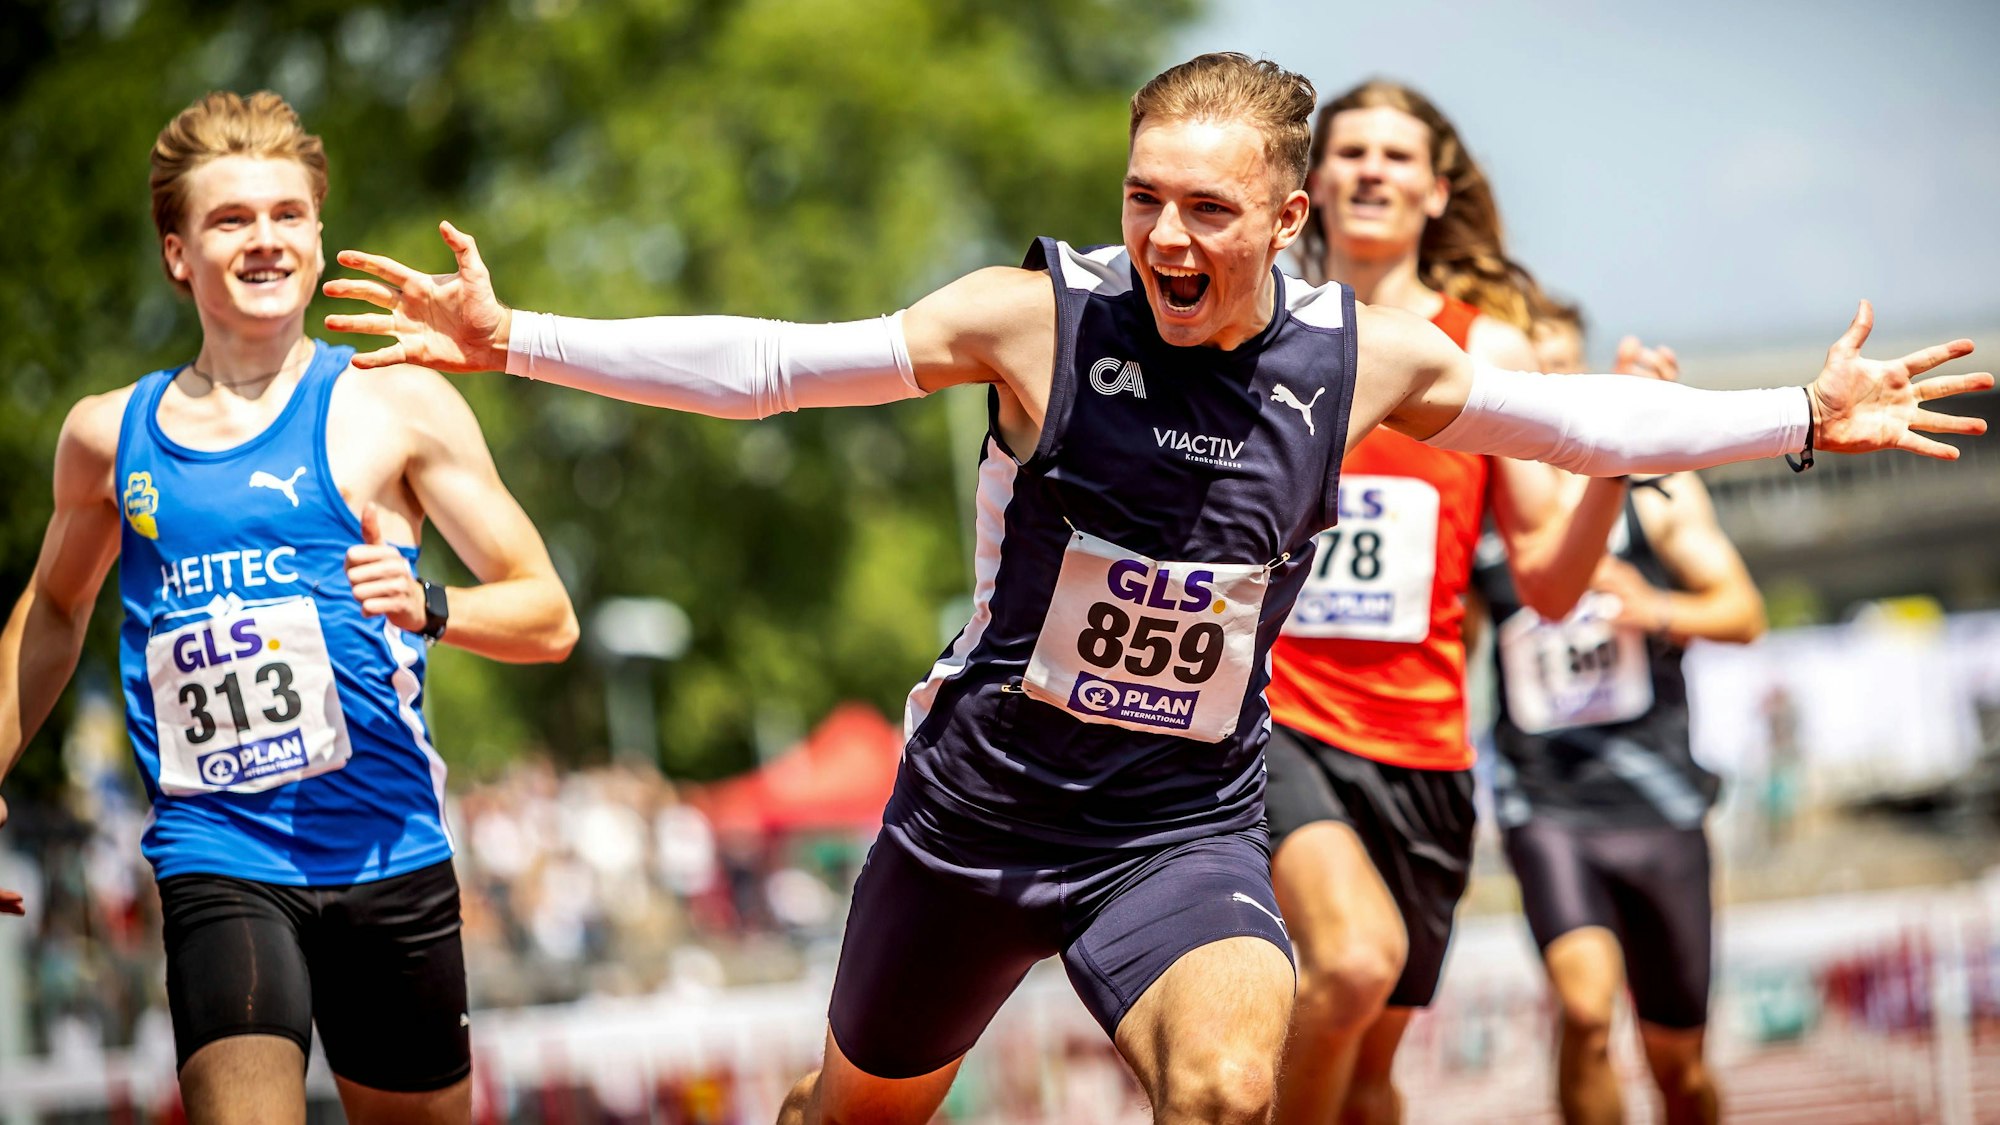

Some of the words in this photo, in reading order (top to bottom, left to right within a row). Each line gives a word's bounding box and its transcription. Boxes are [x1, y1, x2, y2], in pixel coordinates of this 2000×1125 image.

[1153, 427, 1244, 460] VIACTIV
[1185, 453, 1242, 469] Krankenkasse
[160, 546, 299, 601] HEITEC
[1077, 601, 1225, 684] 859
[178, 662, 302, 744] 313
[1120, 709, 1186, 726] INTERNATIONAL
[1123, 689, 1192, 716] PLAN
[239, 736, 302, 770] PLAN
